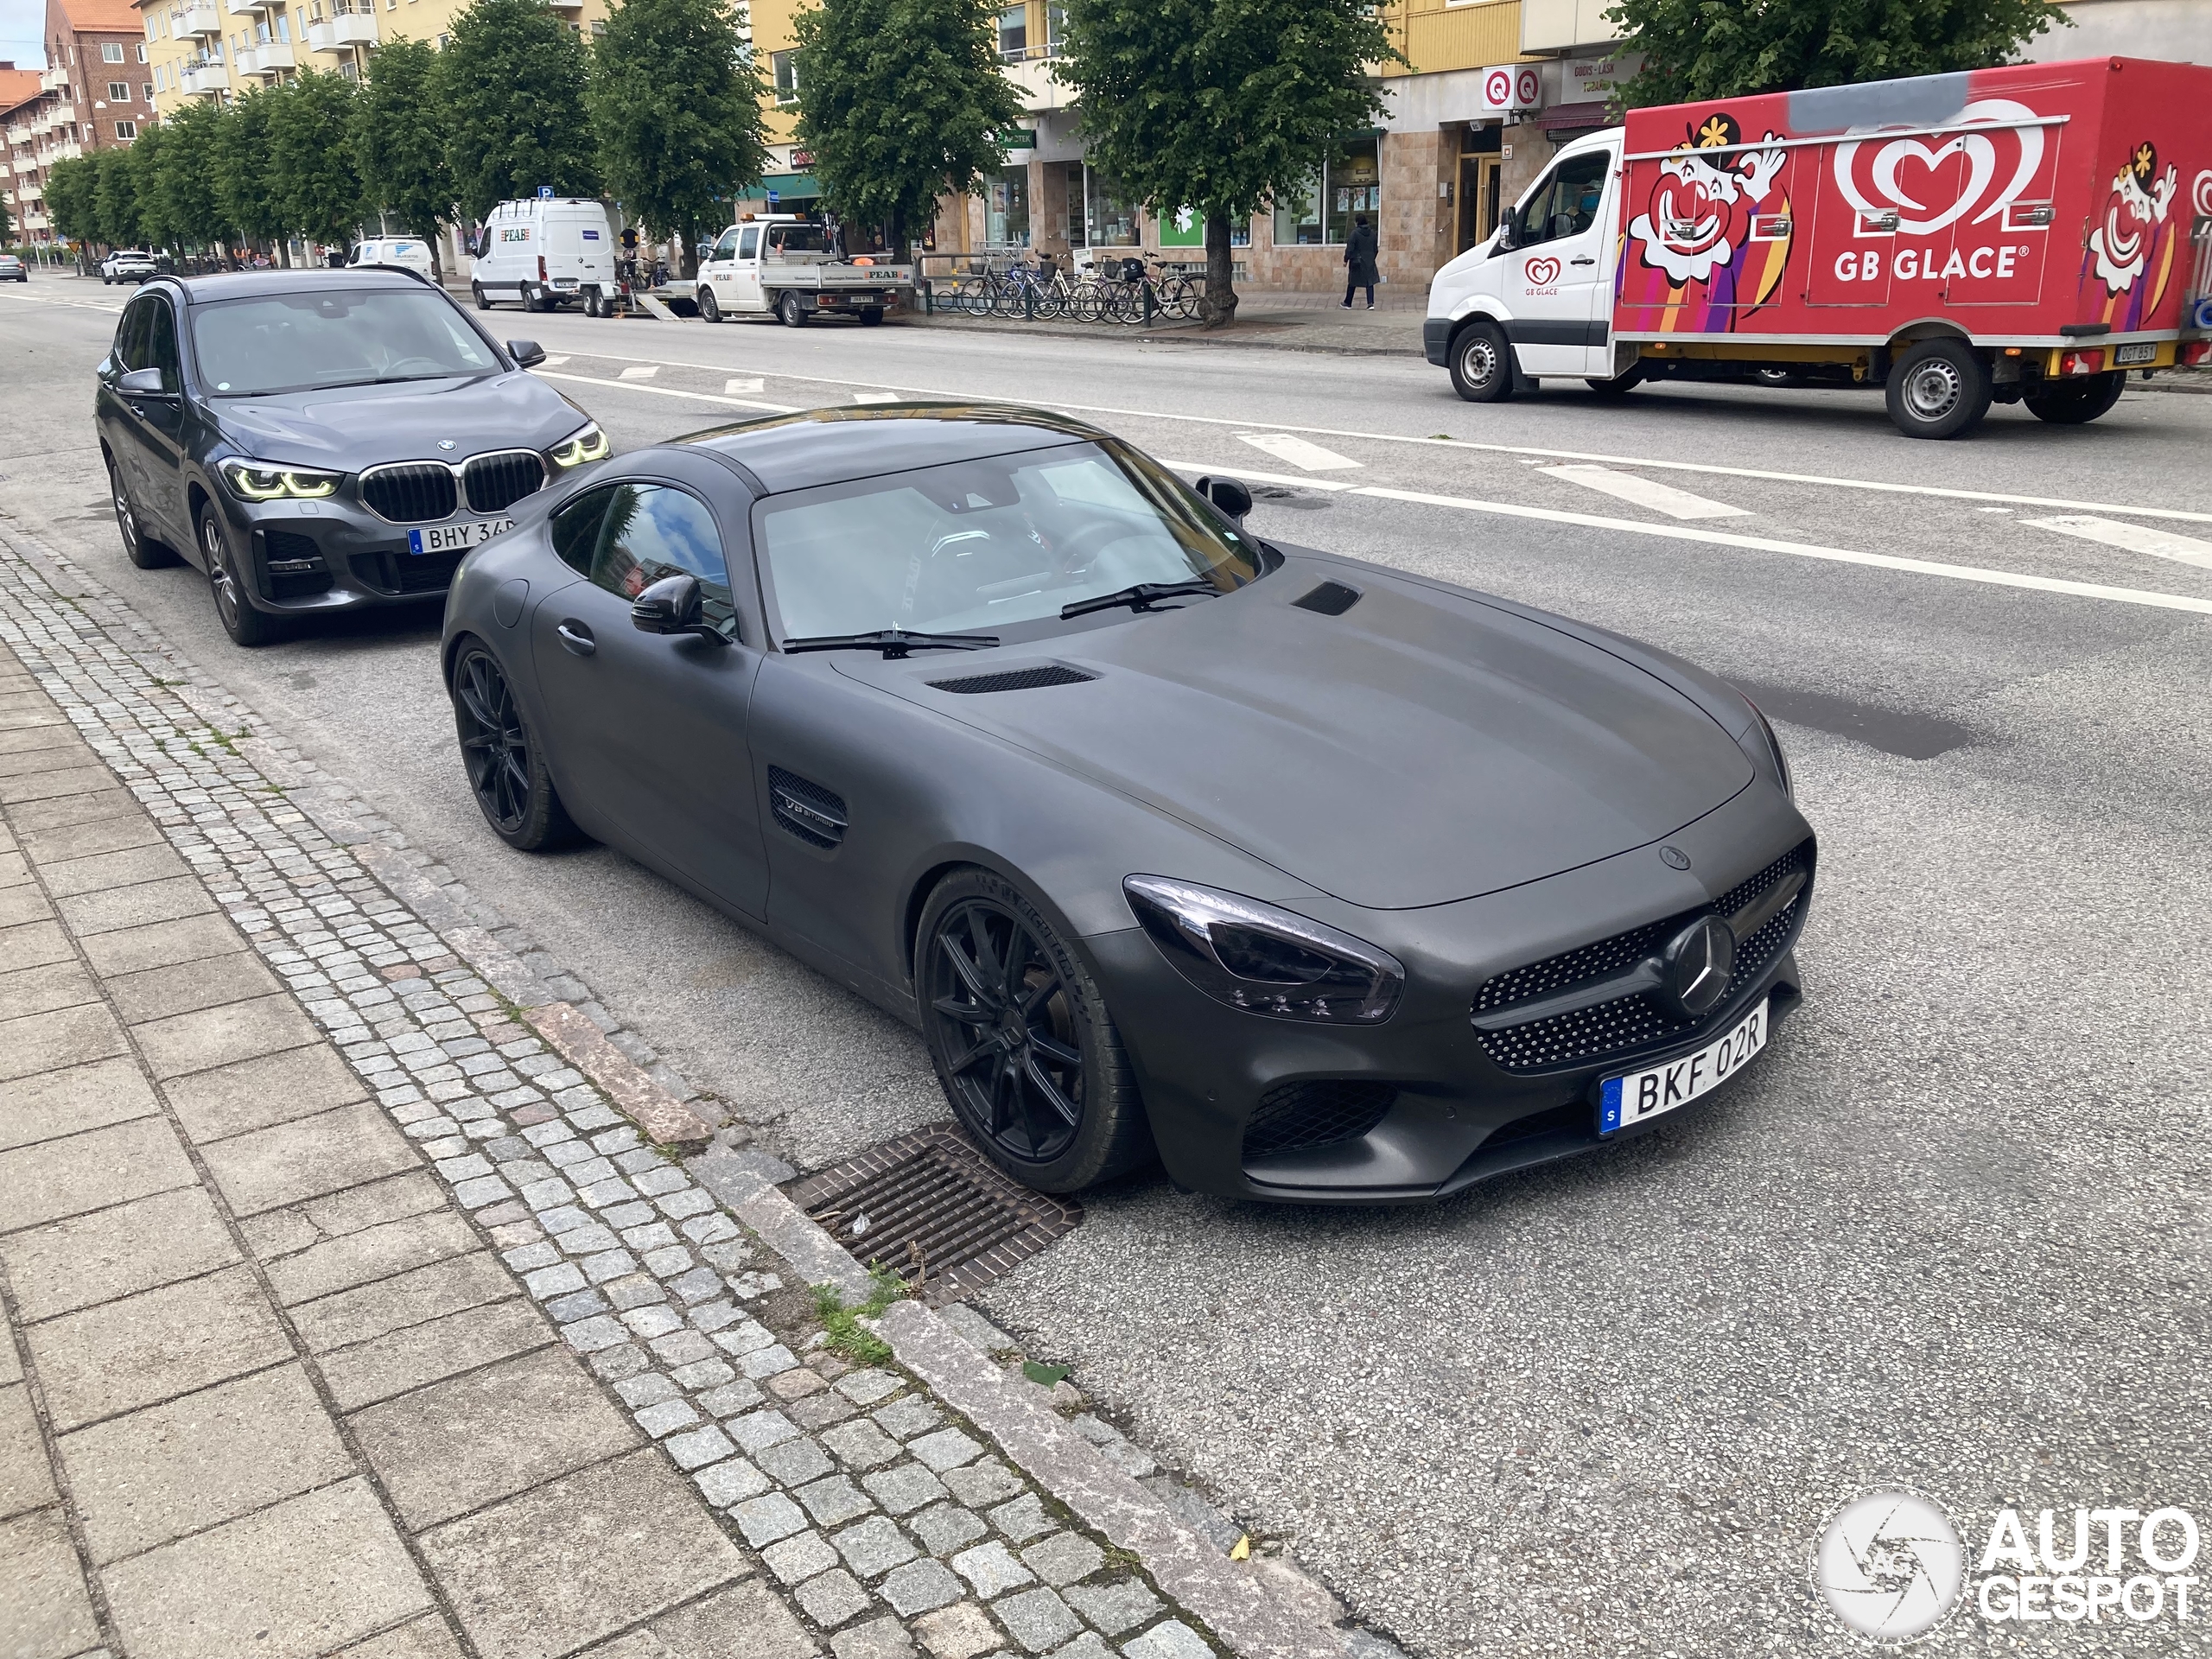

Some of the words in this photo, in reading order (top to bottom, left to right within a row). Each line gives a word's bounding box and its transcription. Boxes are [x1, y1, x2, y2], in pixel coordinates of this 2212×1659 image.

[542, 188, 551, 199] P
[504, 228, 526, 242] PEAB
[1834, 251, 1880, 282] GB
[869, 270, 898, 279] PEAB
[2139, 346, 2154, 359] 851
[429, 525, 469, 549] BHY
[785, 798, 803, 813] V8
[804, 810, 835, 828] BITURBO
[1637, 1052, 1707, 1116] BKF
[1716, 1013, 1759, 1077] 02R
[1606, 1109, 1615, 1122] S
